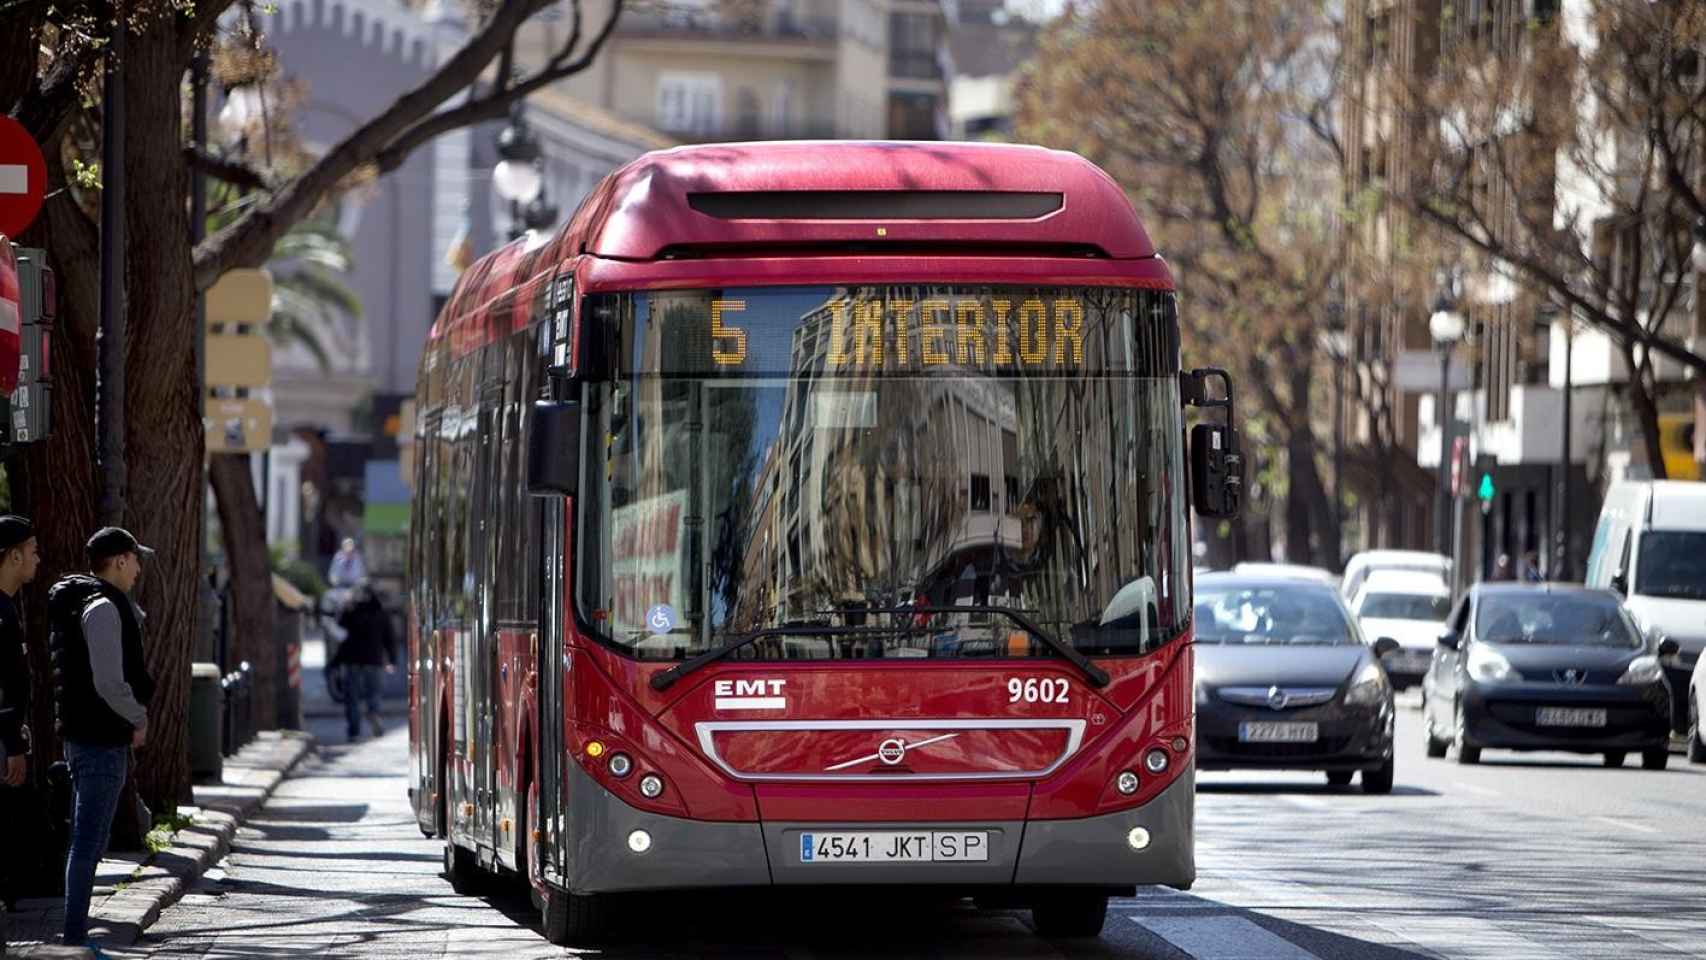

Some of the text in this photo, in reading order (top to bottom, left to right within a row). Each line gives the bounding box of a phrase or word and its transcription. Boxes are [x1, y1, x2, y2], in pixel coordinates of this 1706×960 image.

[712, 300, 1085, 364] 5 INTERIOR
[714, 680, 786, 696] EMT
[1007, 677, 1072, 704] 9602
[816, 836, 869, 859] 4541
[886, 836, 927, 858] JKT
